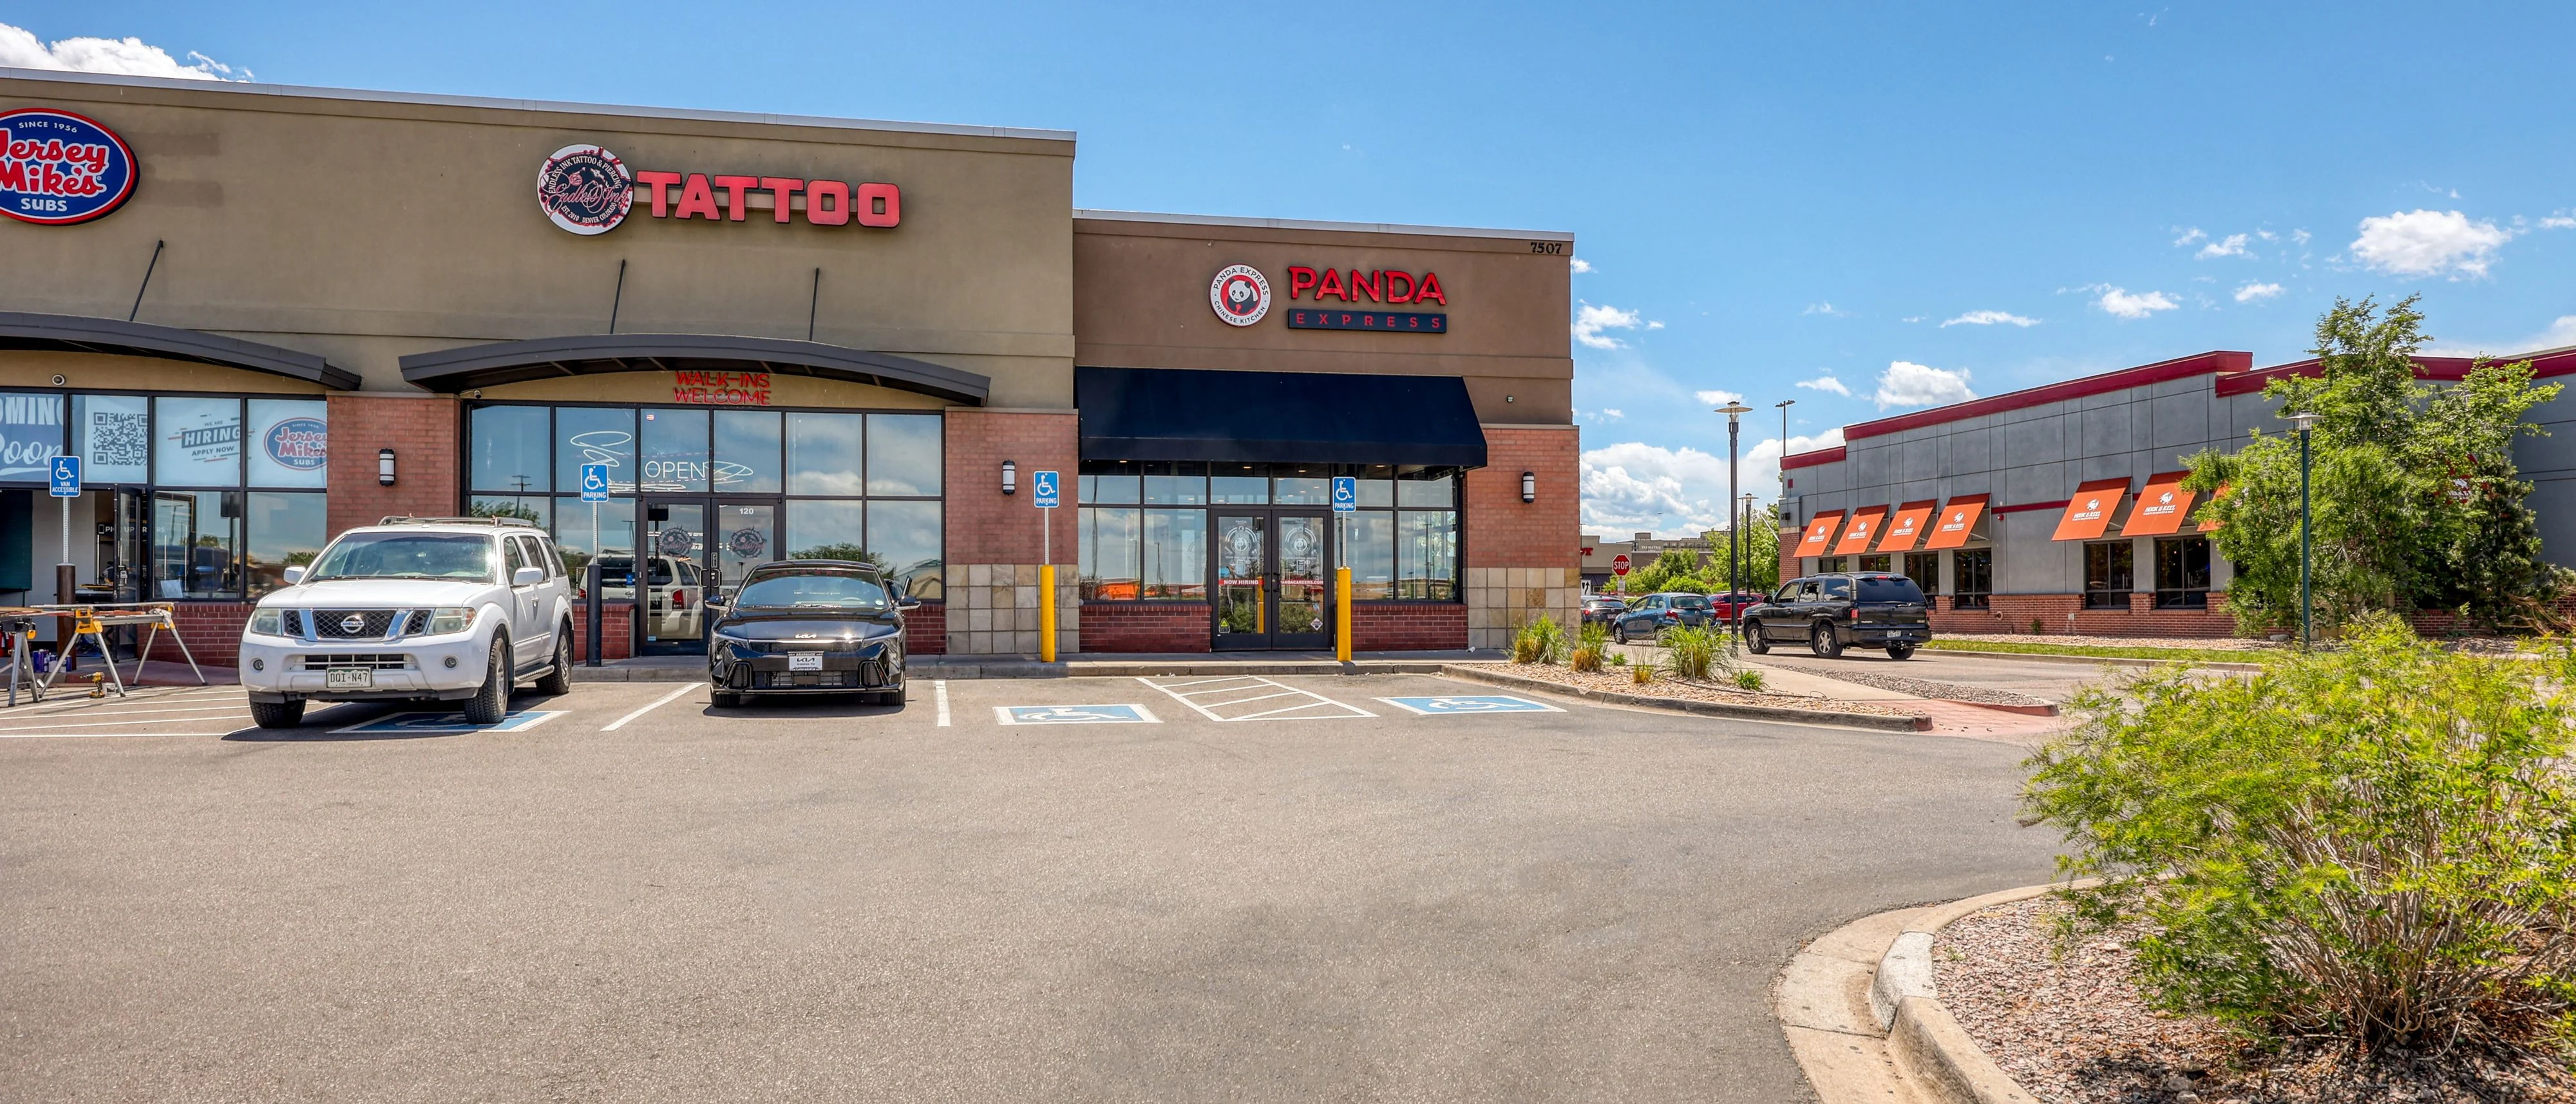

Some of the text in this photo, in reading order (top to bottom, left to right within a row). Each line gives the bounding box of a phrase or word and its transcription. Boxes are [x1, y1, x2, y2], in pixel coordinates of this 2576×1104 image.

[54, 122, 77, 133] 1956
[549, 166, 563, 193] ENDLESS
[559, 158, 573, 170] INK
[571, 156, 596, 164] TATTOO
[601, 162, 622, 189] PIERCING
[21, 198, 68, 212] SUBS
[636, 170, 901, 228] TATTOO
[567, 213, 580, 222] 2010
[599, 202, 617, 220] COLORADO
[1530, 242, 1562, 254] 7507
[1214, 267, 1269, 296] PANDA EXPRESS
[1288, 266, 1447, 305] PANDA
[1215, 300, 1265, 324] CHINESE KITCHEN
[1296, 312, 1440, 328] EXPRESS
[675, 370, 770, 388] WALK-INS
[673, 387, 772, 405] WELCOME
[645, 461, 706, 479] OPEN
[1614, 561, 1629, 570] STOP
